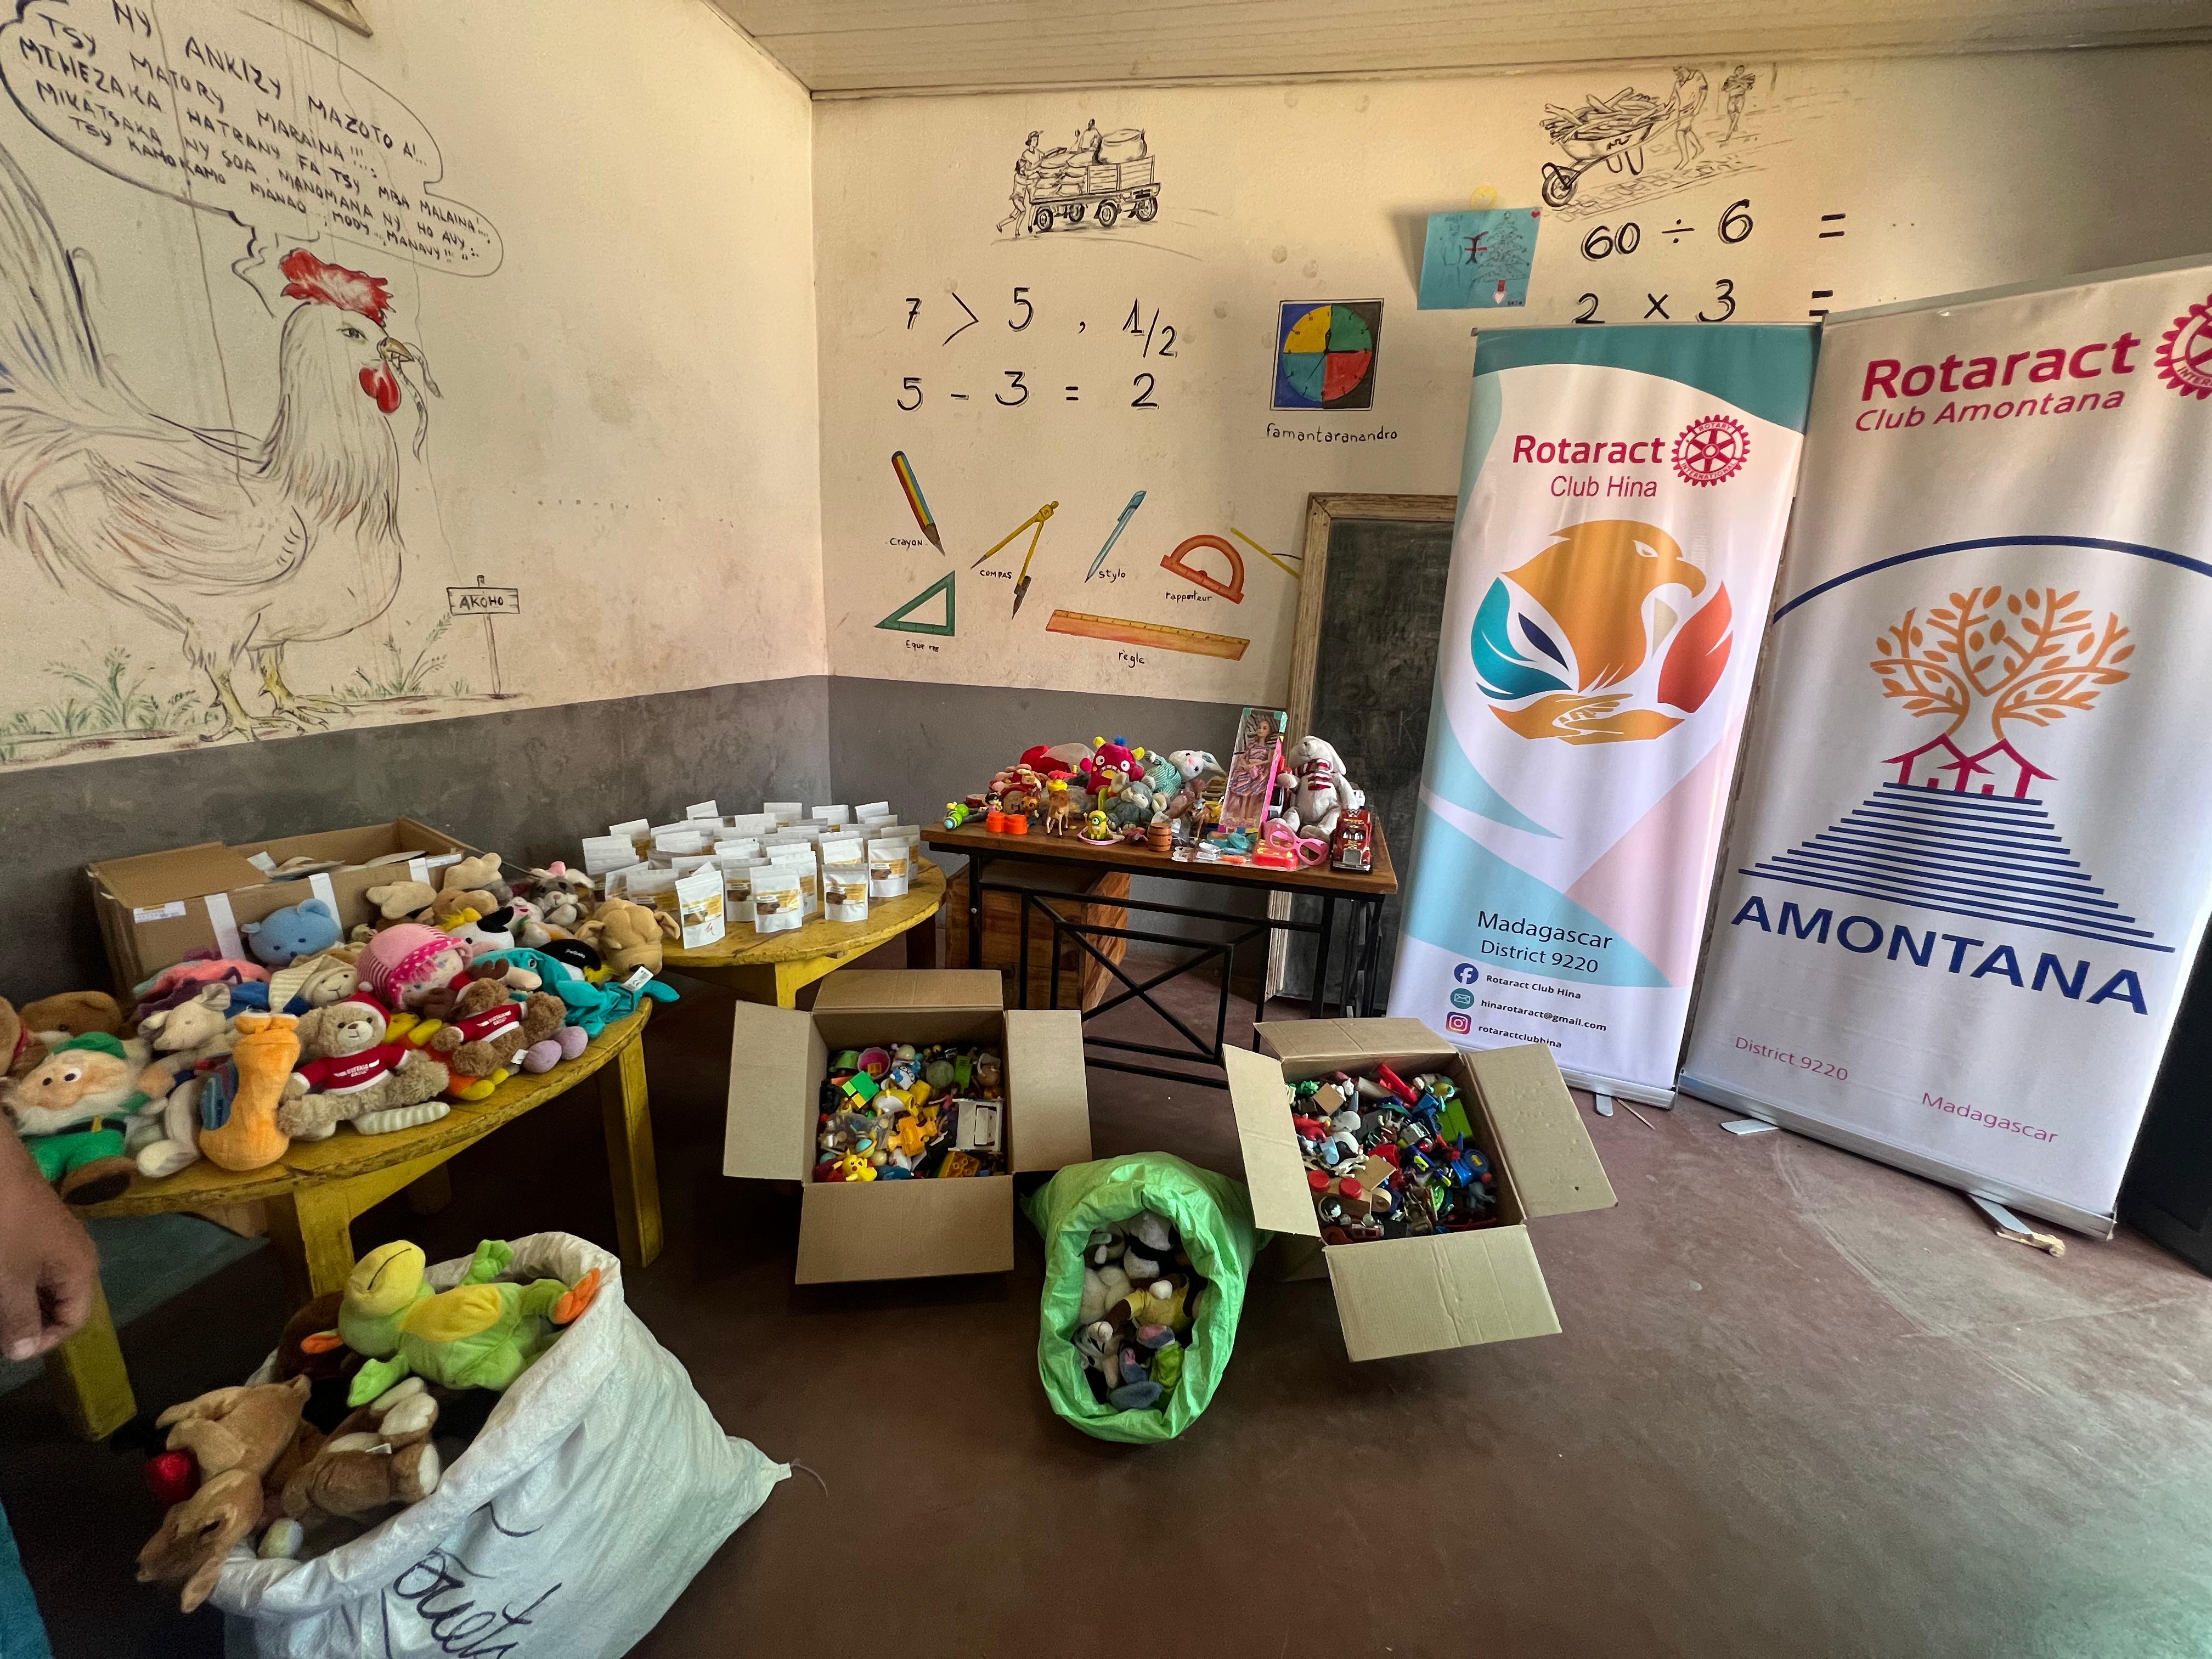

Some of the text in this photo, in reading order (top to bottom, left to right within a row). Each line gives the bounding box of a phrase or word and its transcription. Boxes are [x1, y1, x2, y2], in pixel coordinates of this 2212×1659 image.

[36, 12, 97, 57] TSY
[129, 51, 224, 114] MATORY
[185, 36, 281, 99] ANKIZY
[308, 95, 394, 149] MAZOTO
[67, 115, 112, 146] TSY
[250, 181, 307, 214] MANAO
[296, 153, 323, 176] FA
[329, 167, 361, 195] TSY
[185, 136, 210, 161] NY
[382, 211, 400, 233] NY
[417, 221, 434, 238] HO
[1581, 222, 1640, 262] 60
[1718, 199, 1753, 244] 6
[906, 297, 922, 330] 7
[1008, 287, 1034, 332] 5
[1573, 292, 1606, 324] 2
[1697, 279, 1736, 323] 3
[1861, 331, 2142, 402] Rotaract
[897, 377, 923, 411] 5
[995, 371, 1029, 407] 3
[1131, 373, 1160, 410] 2
[1855, 390, 2126, 432] Club Amontana
[1266, 422, 1398, 443] famantaranandro
[1698, 422, 1733, 432] ROTARY
[1513, 435, 1665, 464] Rotaract
[1550, 476, 1657, 498] Club Hina
[1680, 462, 1737, 480] INTERNATIONAL
[1098, 568, 1126, 584] stylo
[459, 595, 504, 611] AKOHO
[1119, 649, 1146, 668] règle
[1477, 910, 1613, 950] Madagascar
[1481, 939, 1599, 973] District 9220
[1730, 894, 2149, 1016] AMONTANA
[1486, 974, 1582, 1000] Rotaract Club Hina
[1481, 999, 1607, 1032] hinarotaract@gmail.com
[1478, 1025, 1562, 1048] rotaractclubhina
[1735, 1036, 1849, 1082] District 9220
[1921, 1091, 2059, 1145] Madagascar
